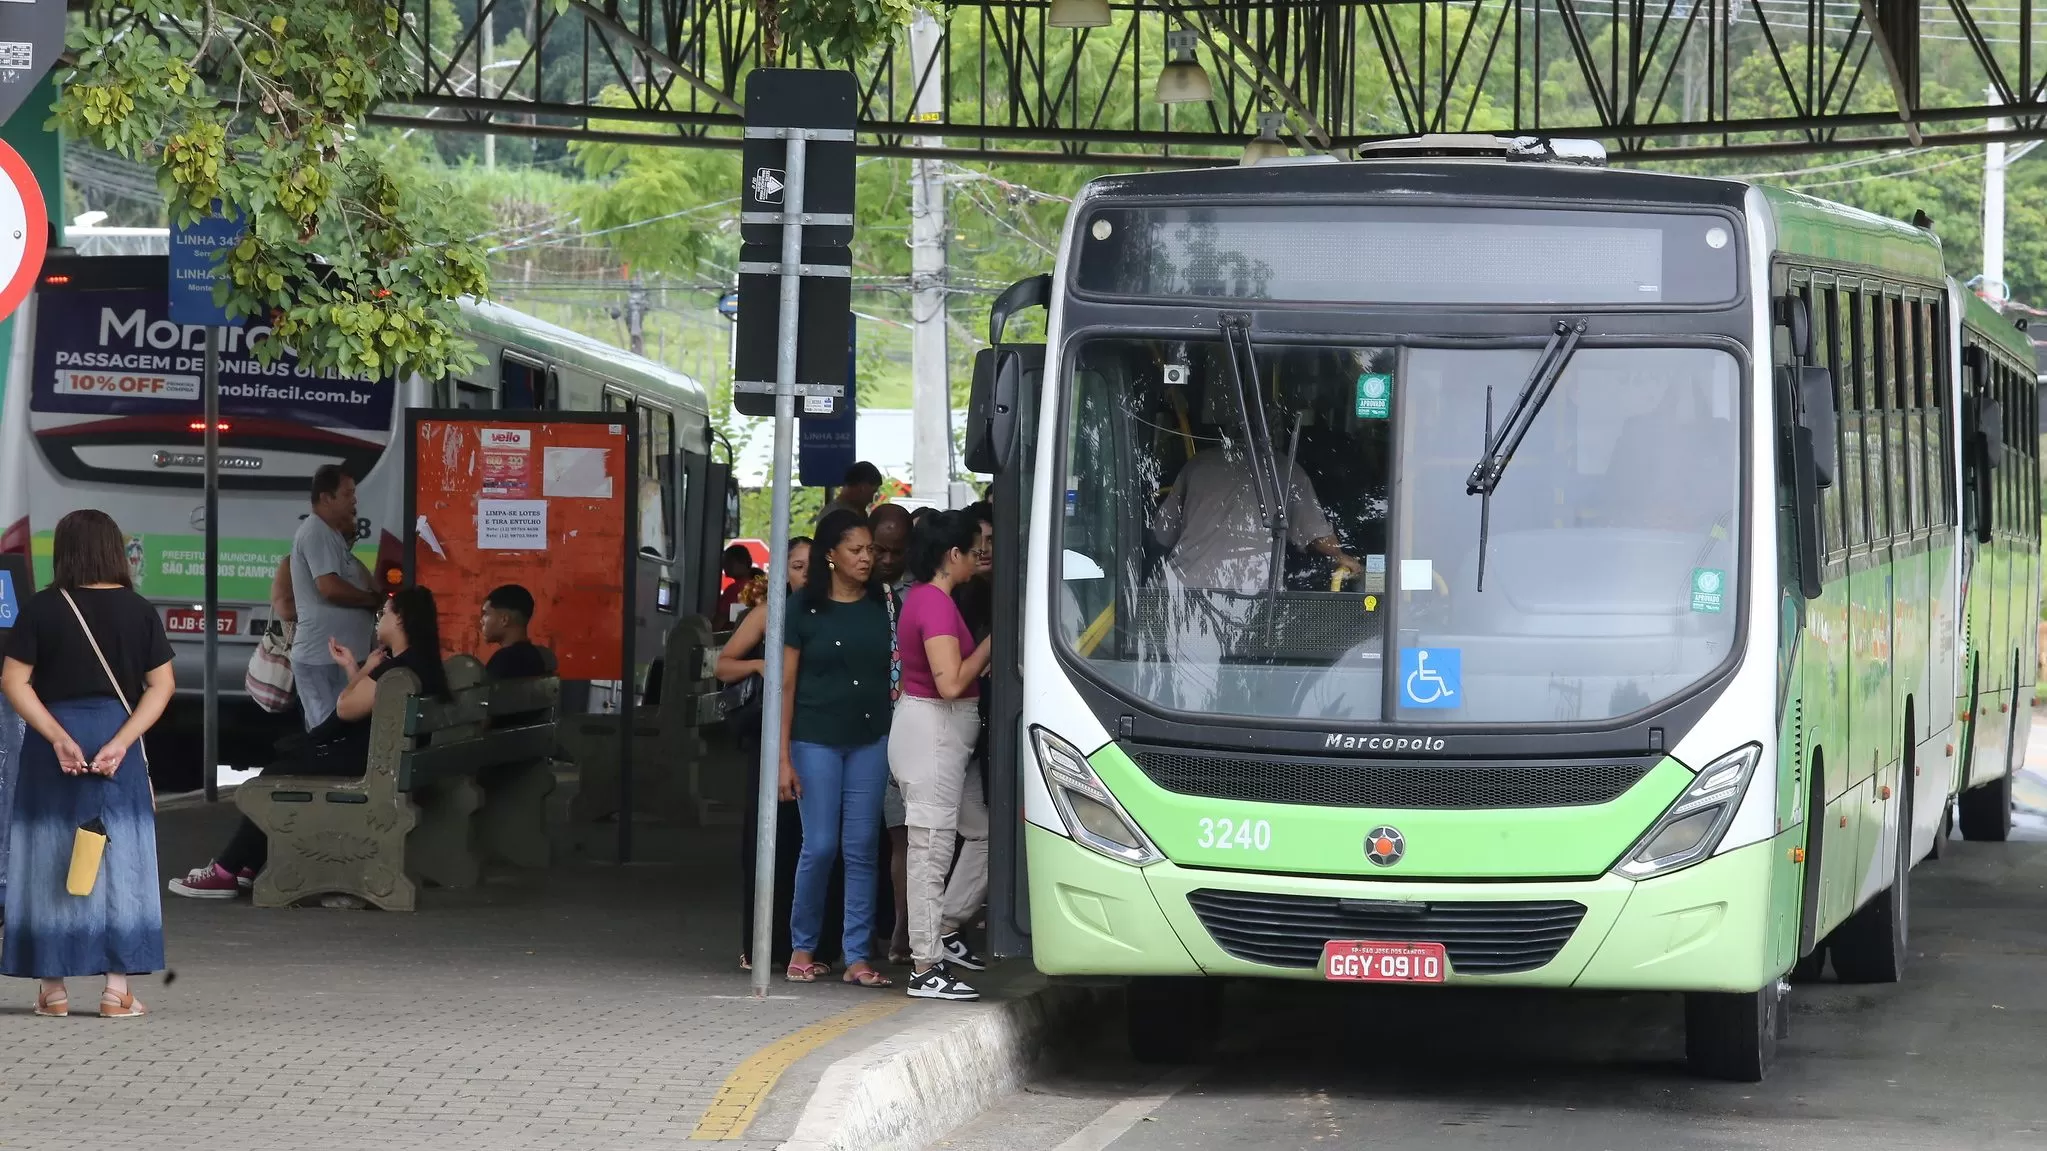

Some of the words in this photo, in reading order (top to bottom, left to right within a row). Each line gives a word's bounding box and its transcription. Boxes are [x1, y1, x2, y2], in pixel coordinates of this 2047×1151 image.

[176, 235, 216, 246] LINHA
[176, 269, 216, 280] LINHA
[55, 351, 171, 370] PASSAGEM
[175, 357, 205, 372] DE
[70, 374, 117, 392] 10%
[119, 376, 166, 394] OFF
[218, 383, 372, 405] mobifacil.com.br
[161, 550, 206, 561] PREFEITU
[219, 553, 268, 564] MUNICIPAL
[161, 560, 184, 576] SÃO
[185, 563, 207, 577] JOS
[237, 564, 276, 579] CAMPO
[1324, 733, 1446, 752] Marcopolo
[1197, 816, 1272, 852] 3240
[1402, 948, 1426, 956] CAMPOS
